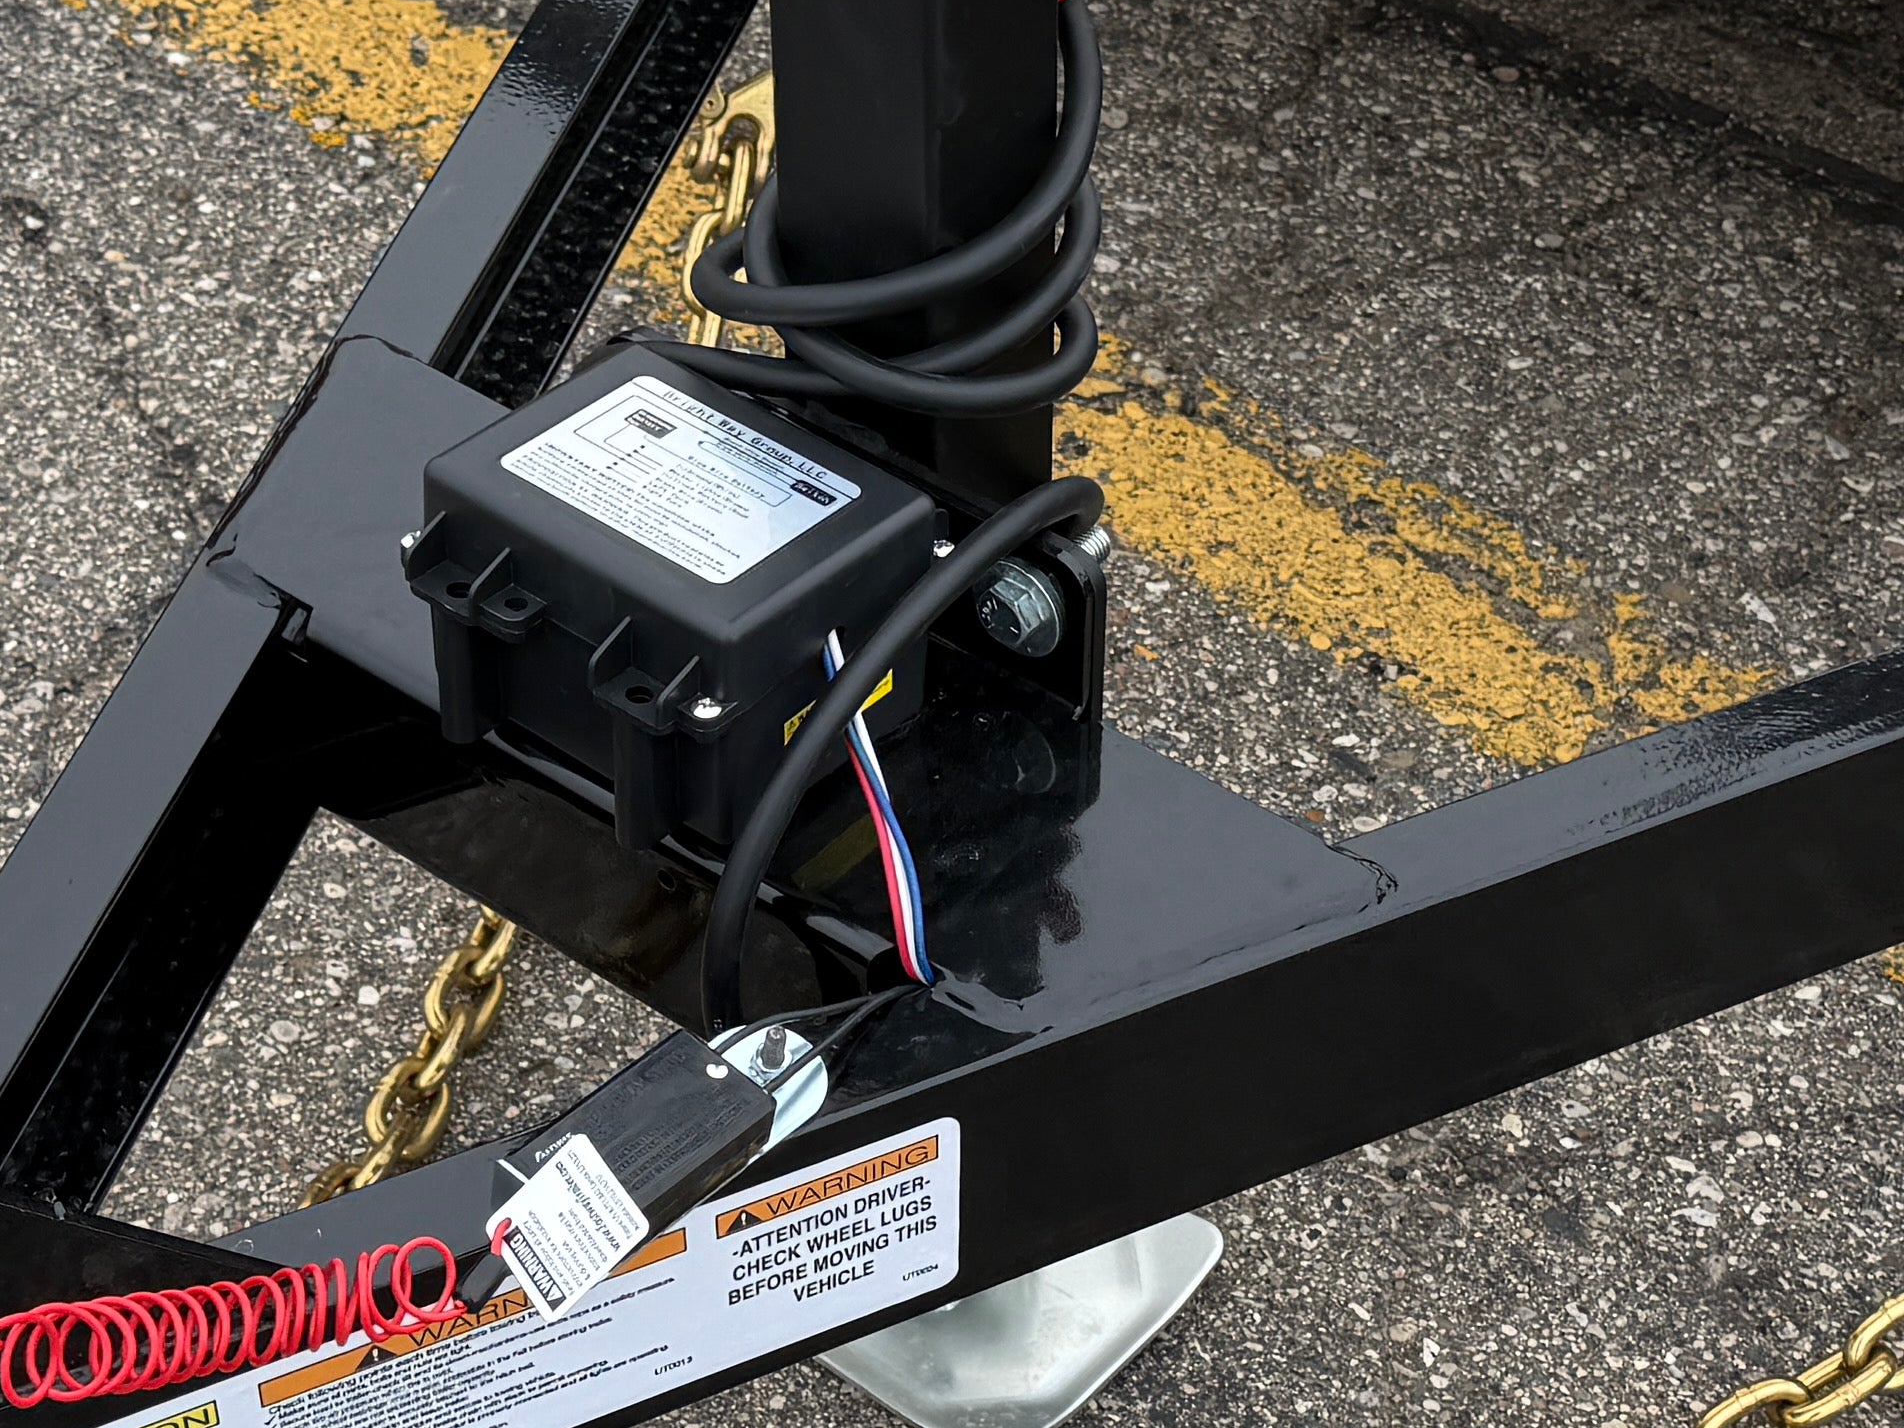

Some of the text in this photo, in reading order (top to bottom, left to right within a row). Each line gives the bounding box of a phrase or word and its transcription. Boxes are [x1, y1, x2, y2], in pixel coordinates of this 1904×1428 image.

[715, 418, 748, 438] Way
[797, 461, 828, 479] LLC
[766, 1143, 928, 1218] WARNING
[733, 1176, 930, 1257] -ATTENTION DRIVER-
[733, 1196, 931, 1281] CHECK WHEEL LUGS
[507, 1231, 555, 1295] WARNING
[729, 1216, 936, 1305] BEFORE MOVING THIS
[794, 1260, 874, 1301] VEHICLE
[409, 1288, 534, 1346] WARN
[268, 1395, 305, 1416] Check
[308, 1375, 356, 1403] following
